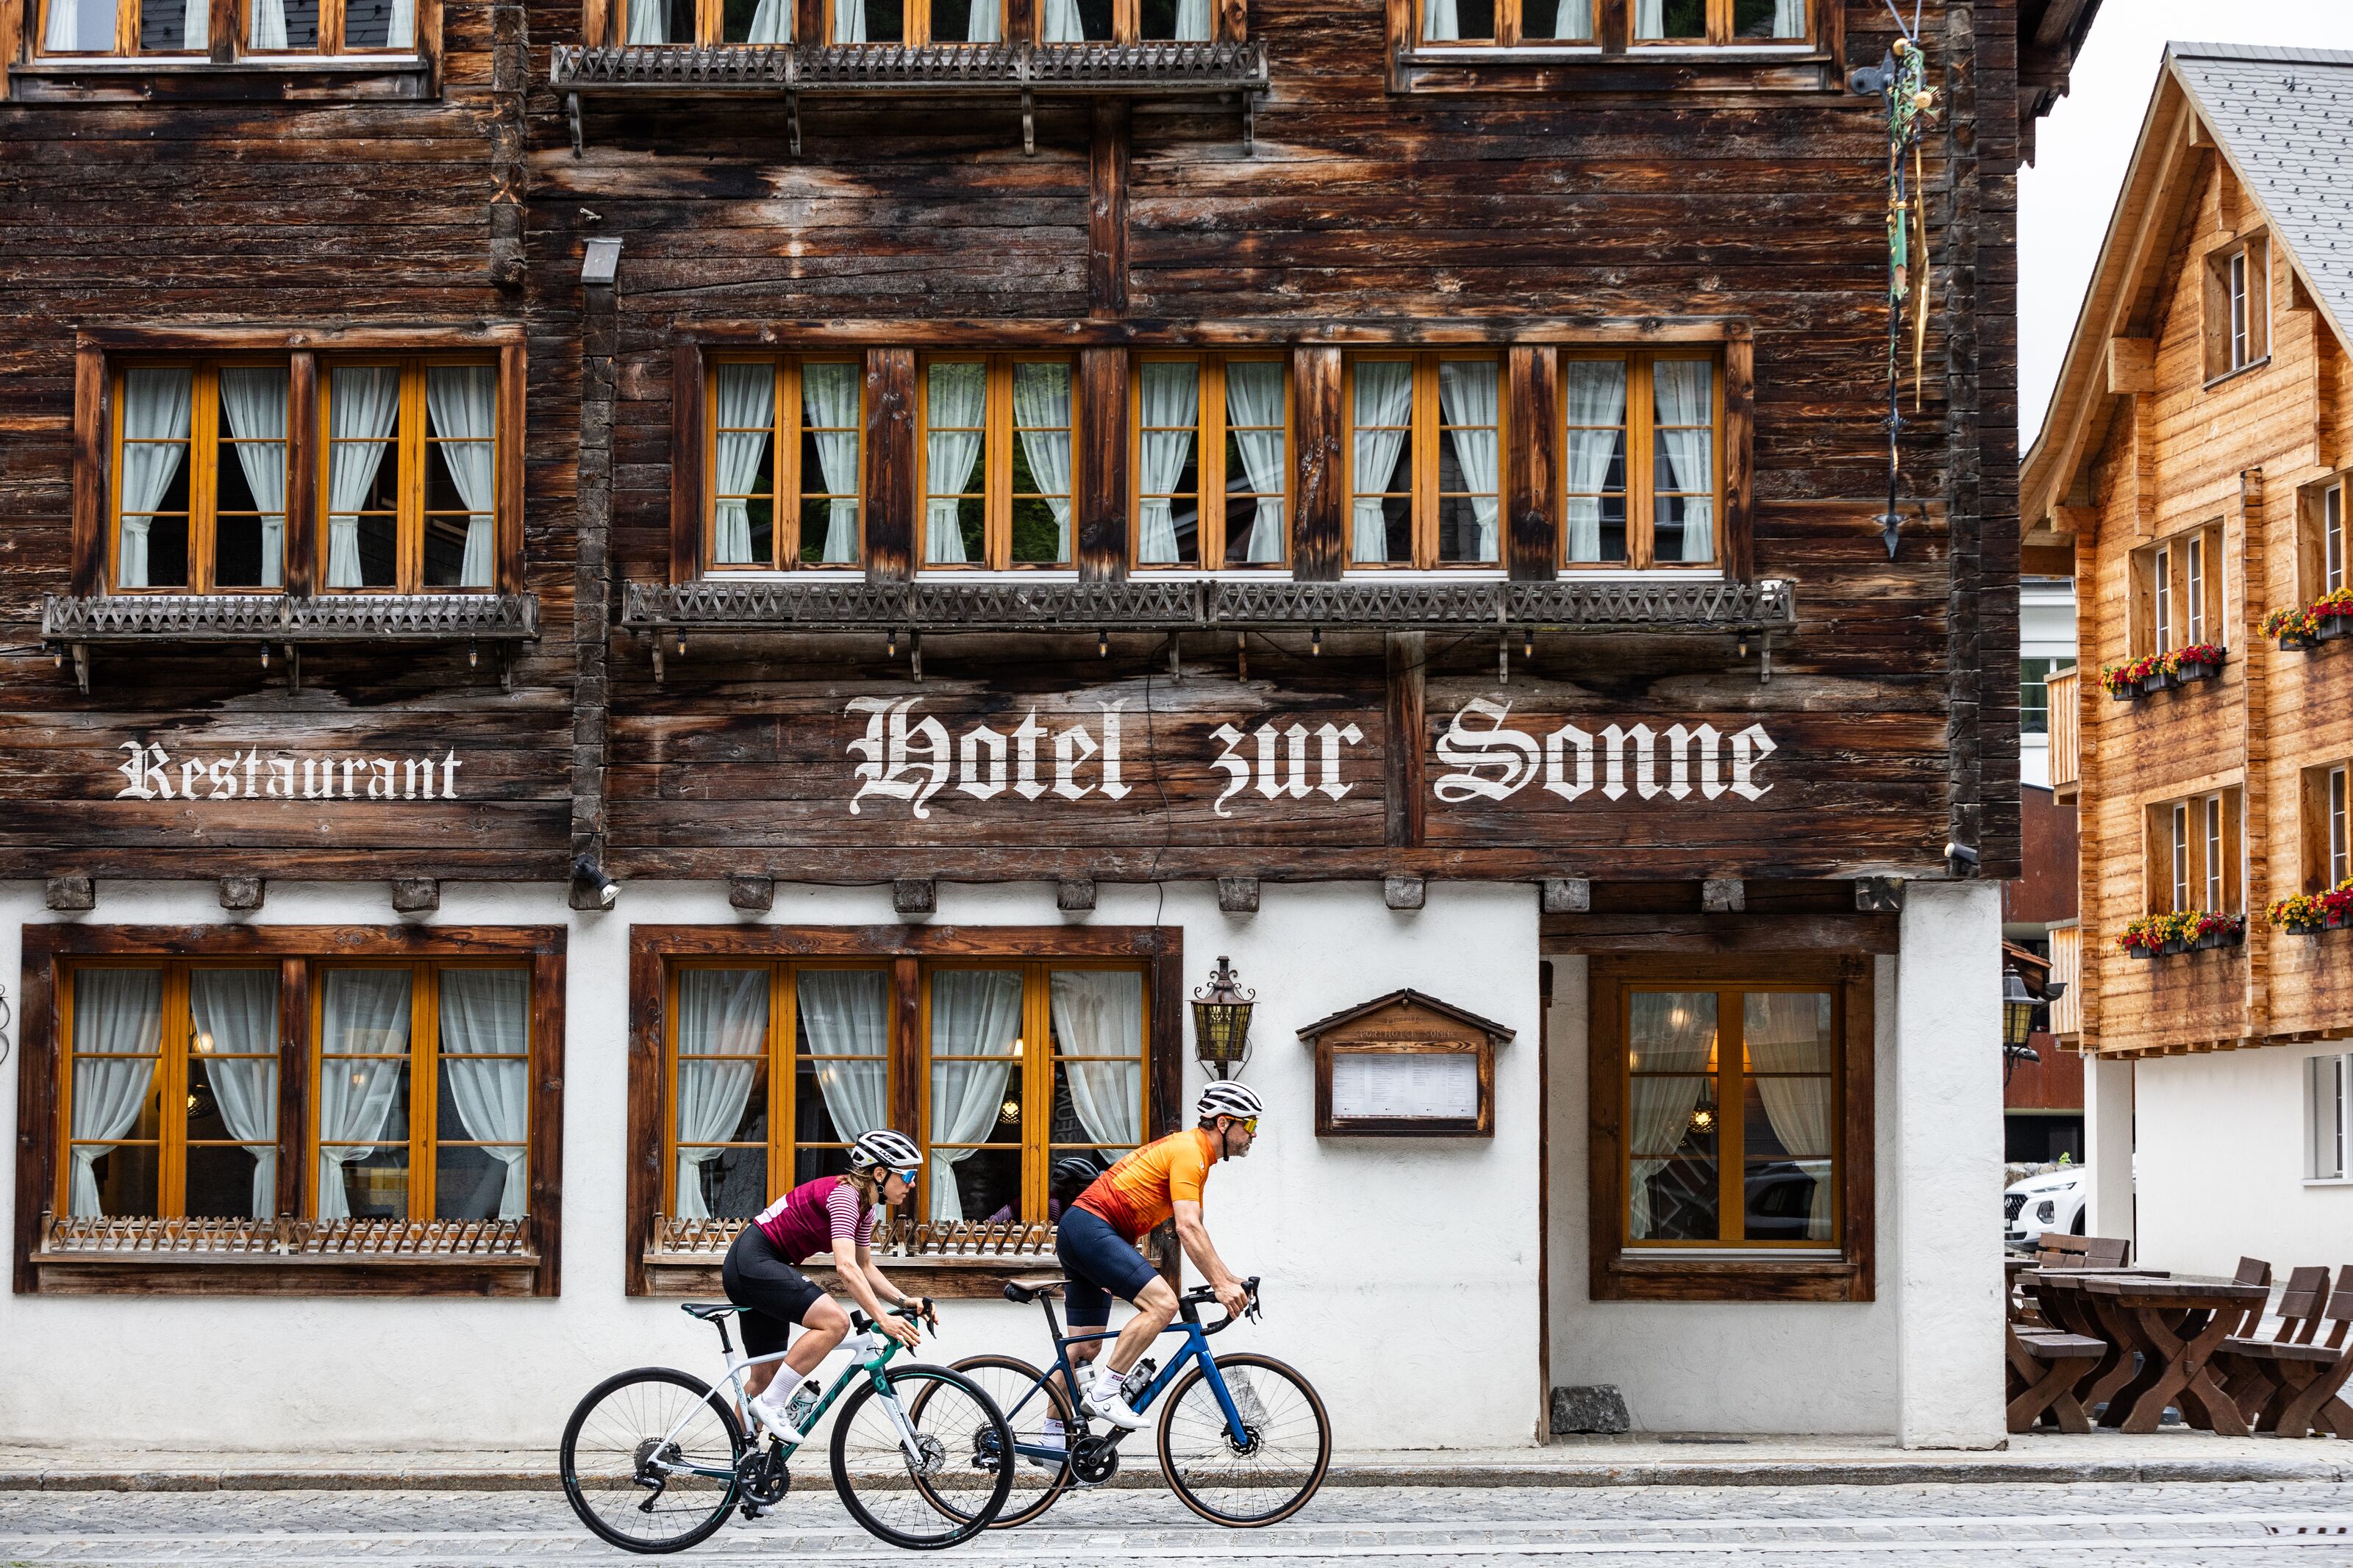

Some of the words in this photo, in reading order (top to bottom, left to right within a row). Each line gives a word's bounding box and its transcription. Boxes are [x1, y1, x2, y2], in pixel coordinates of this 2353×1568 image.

[115, 740, 462, 800] Restaurant
[846, 698, 1132, 819] Hotel
[1209, 722, 1364, 818] zur
[1432, 698, 1777, 803] Sonne
[879, 1150, 897, 1163] LAZER
